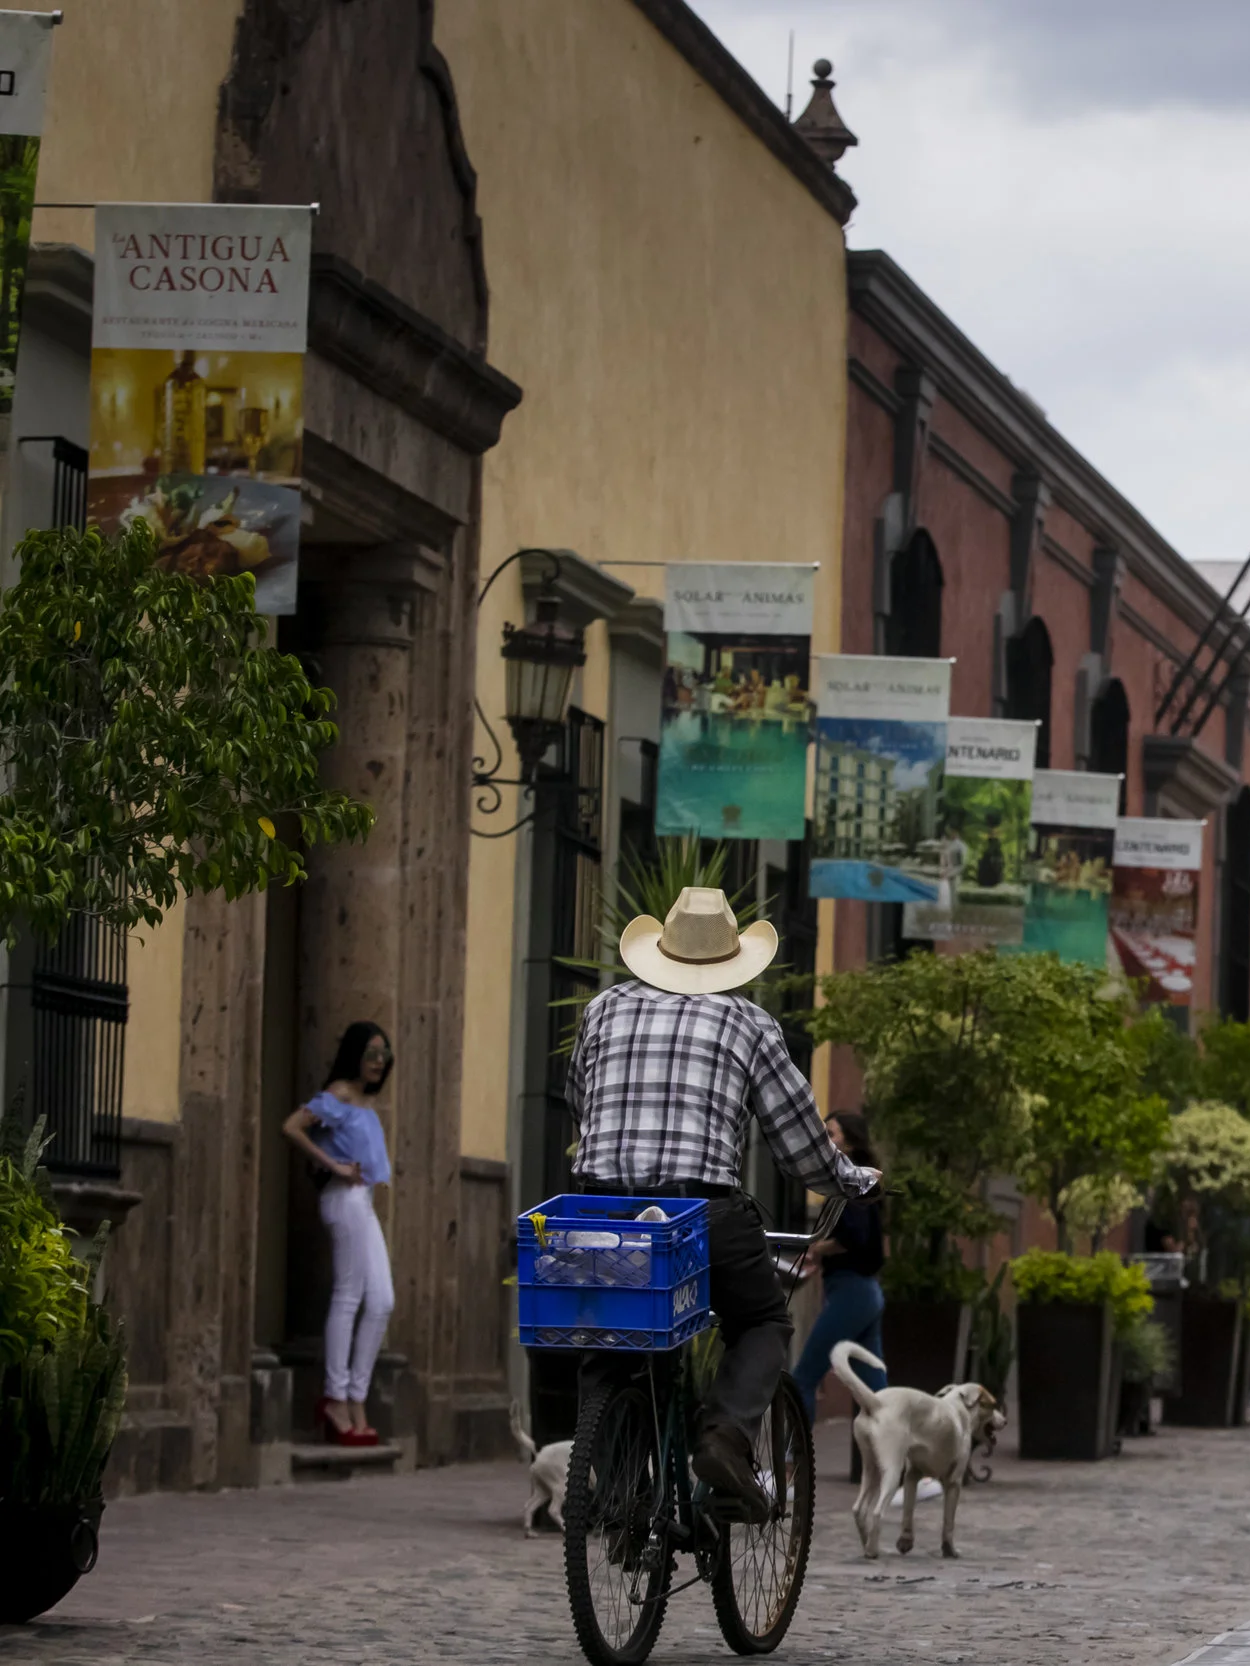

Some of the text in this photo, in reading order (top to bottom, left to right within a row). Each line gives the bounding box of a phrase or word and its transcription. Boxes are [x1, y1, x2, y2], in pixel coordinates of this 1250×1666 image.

[119, 233, 291, 263] ANTIGUA
[129, 265, 279, 294] CASONA
[673, 589, 725, 603] SOLAR
[948, 744, 1021, 763] NTENARIO
